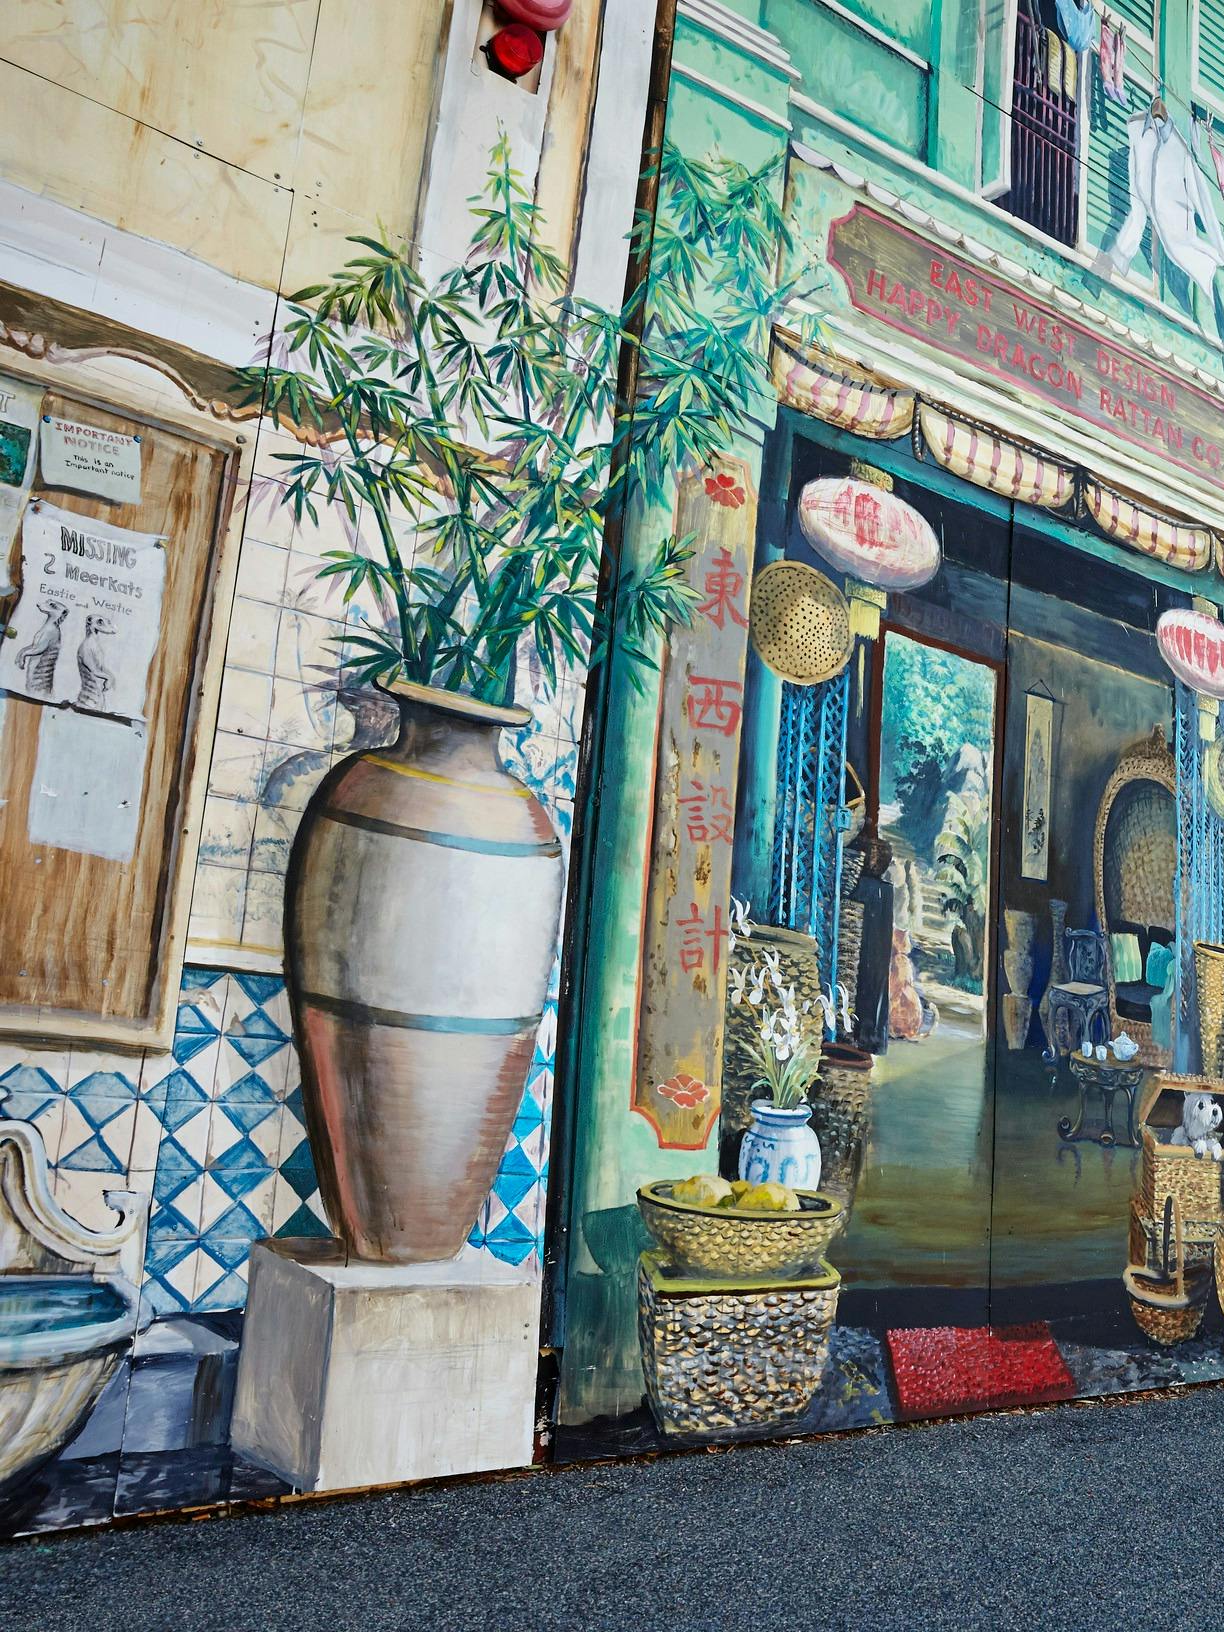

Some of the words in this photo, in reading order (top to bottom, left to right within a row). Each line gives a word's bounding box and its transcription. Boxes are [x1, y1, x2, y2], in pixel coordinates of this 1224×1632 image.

[930, 259, 993, 313] EAST
[1012, 303, 1078, 356] WEST
[1096, 349, 1177, 412] DESIGN
[866, 268, 961, 335] HAPPY
[976, 323, 1083, 400] DRAGON
[1100, 387, 1184, 449] RATTAN
[1191, 436, 1221, 468] CO
[55, 422, 133, 447] IMPORTANT
[64, 436, 120, 456] NOTICE
[73, 454, 88, 463] This
[94, 458, 102, 466] is
[111, 470, 135, 480] notice
[60, 526, 137, 569] MISSING
[43, 552, 56, 575] 2
[39, 583, 77, 601] Eastie
[92, 596, 132, 616] Westie
[677, 546, 749, 976] 東西設計
